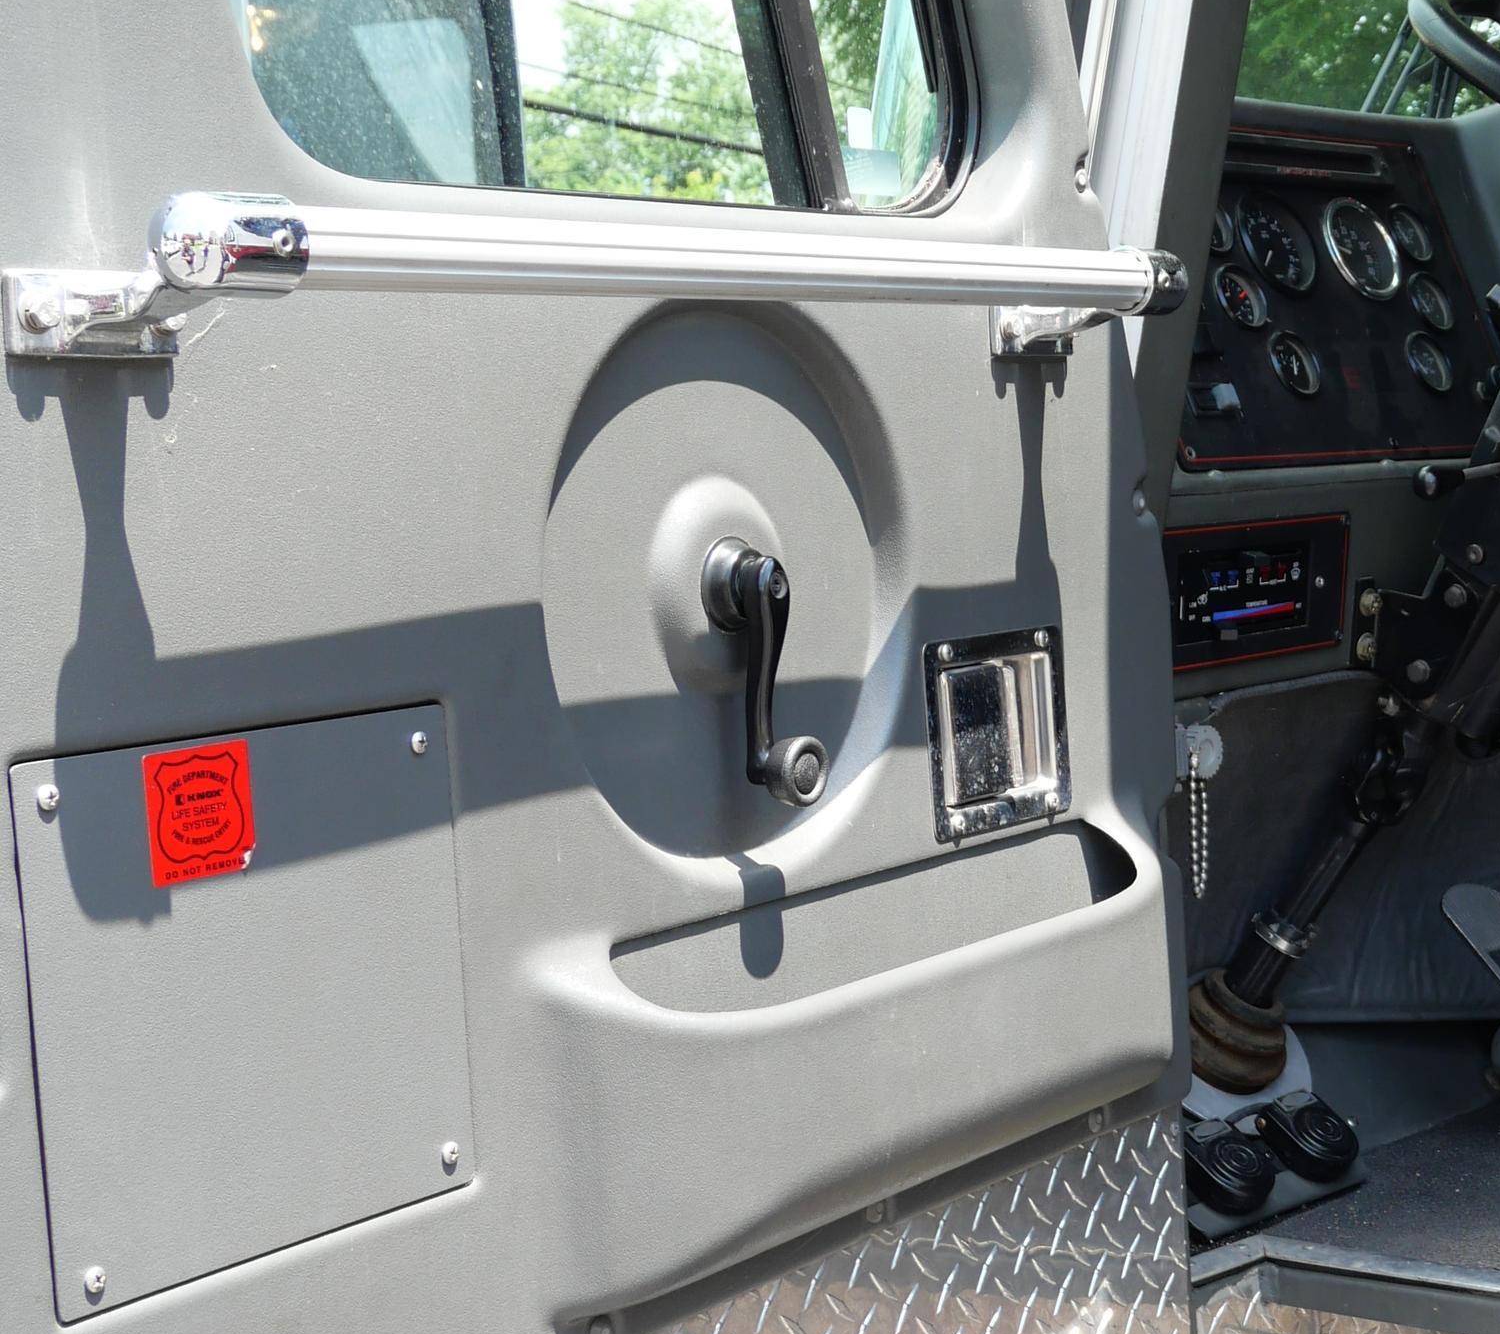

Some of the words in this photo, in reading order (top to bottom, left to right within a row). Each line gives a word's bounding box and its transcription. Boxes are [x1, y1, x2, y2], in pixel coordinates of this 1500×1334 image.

[193, 801, 227, 816] SAFETY
[182, 817, 219, 832] SYSTEM
[165, 870, 179, 880] DO
[182, 865, 202, 876] NOT
